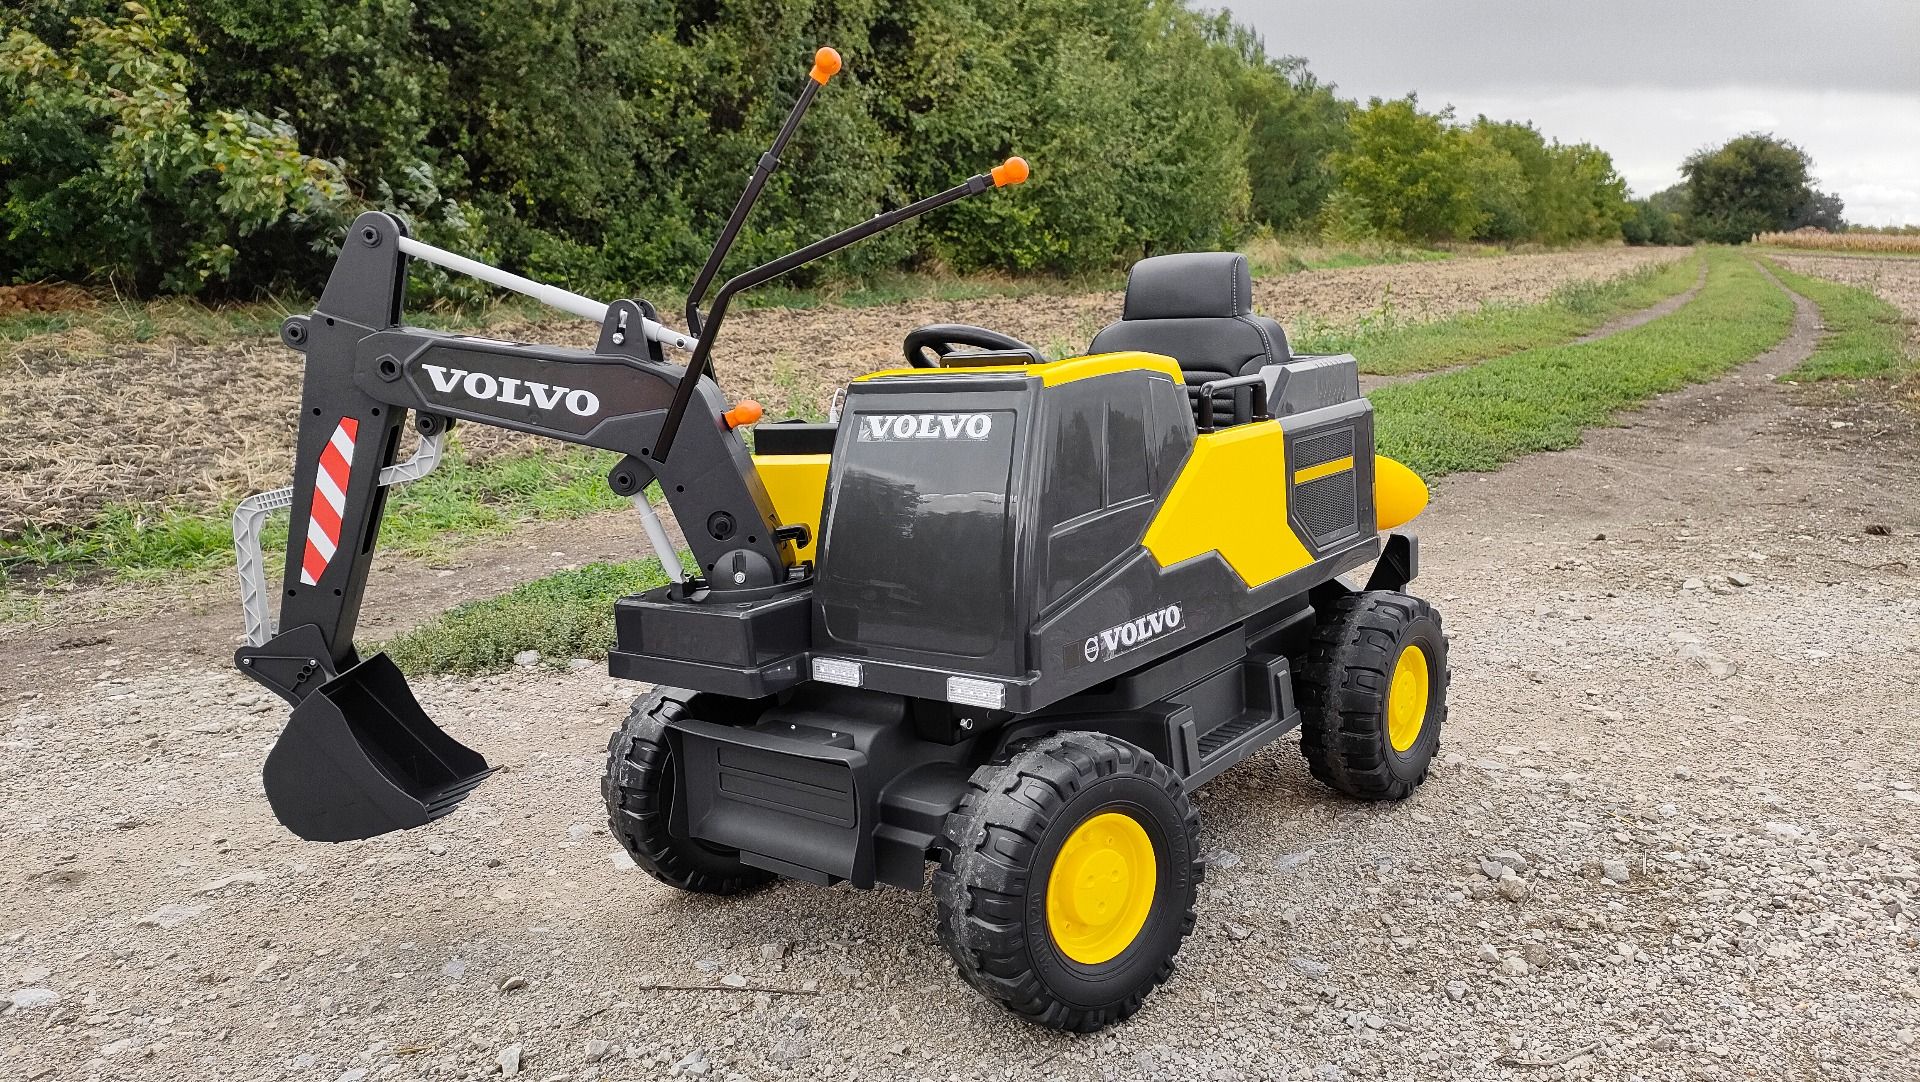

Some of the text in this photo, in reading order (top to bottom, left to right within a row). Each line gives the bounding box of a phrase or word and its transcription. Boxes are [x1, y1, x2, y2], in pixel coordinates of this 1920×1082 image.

[421, 364, 600, 417] VOLVO
[866, 414, 993, 439] VOLVO
[1101, 605, 1181, 651] VOLVO
